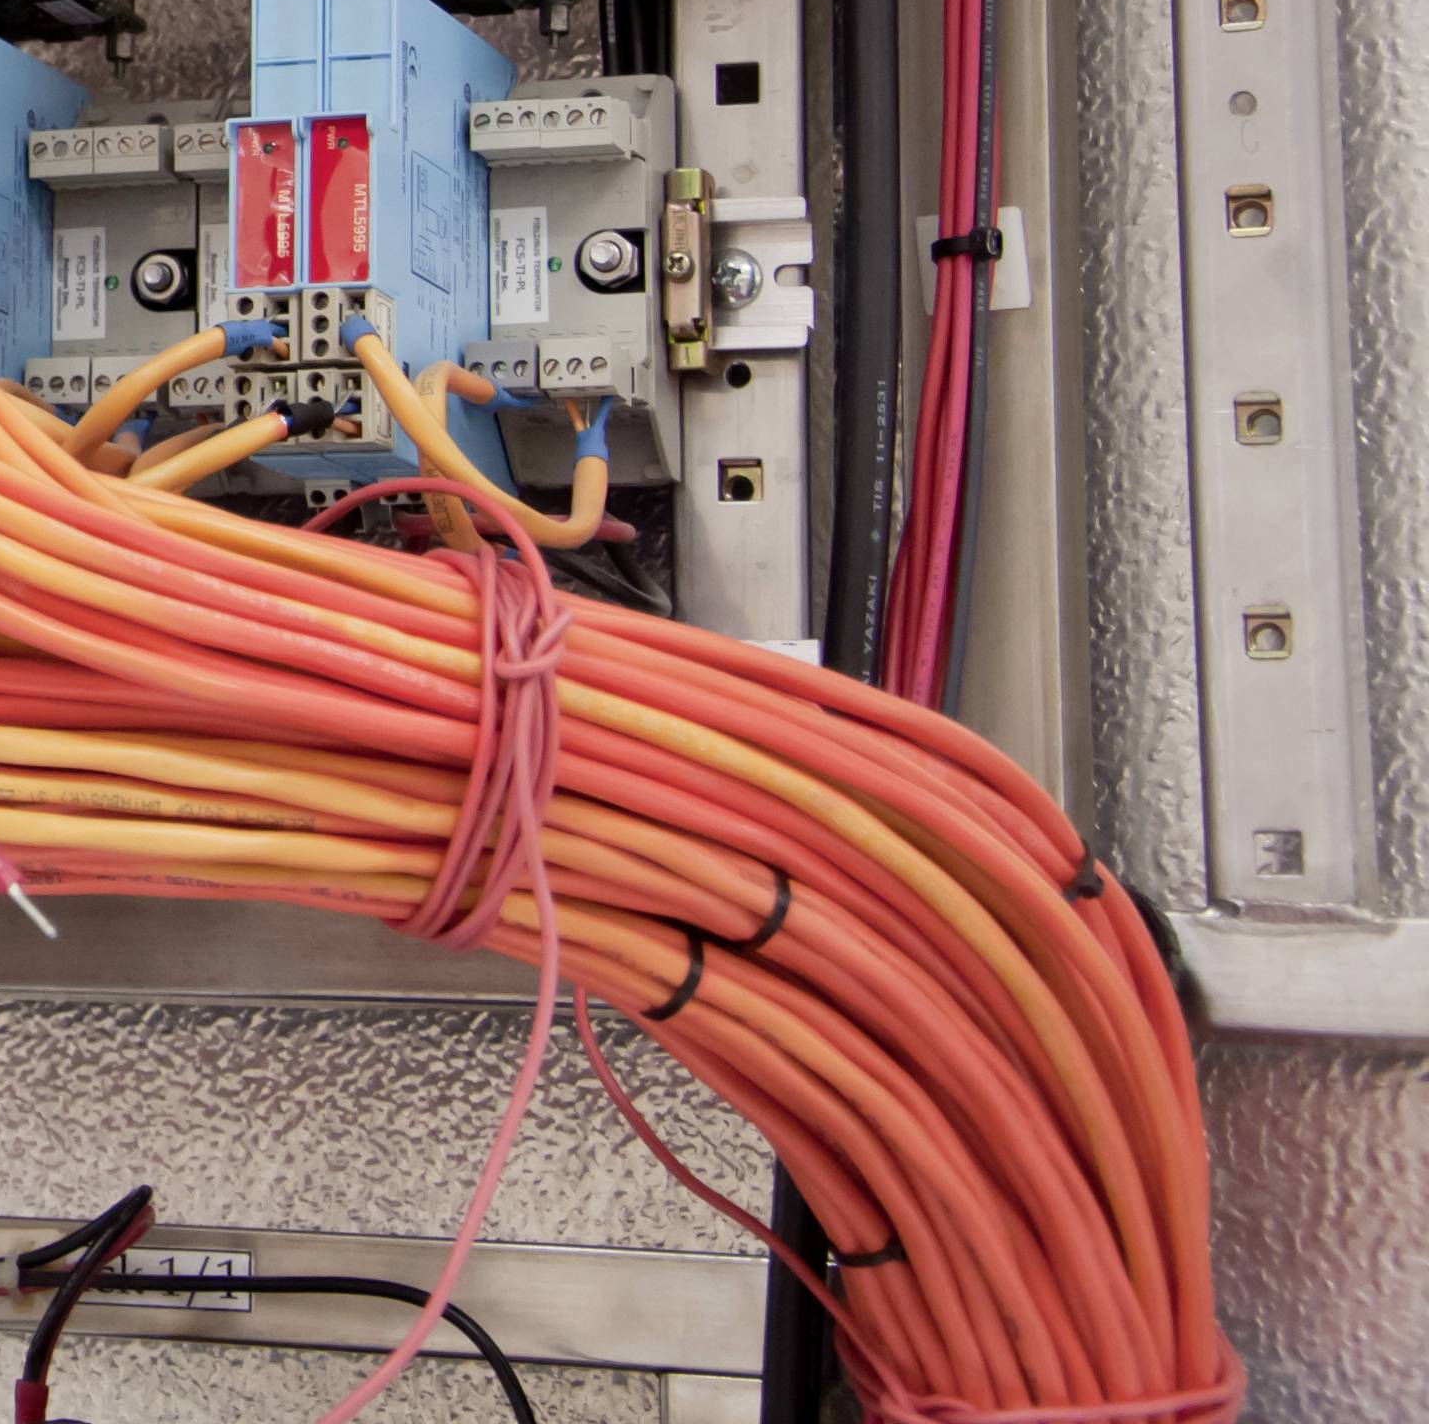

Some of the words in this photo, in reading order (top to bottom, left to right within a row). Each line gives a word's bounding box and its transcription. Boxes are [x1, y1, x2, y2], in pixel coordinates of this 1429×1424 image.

[325, 124, 336, 151] PWR
[352, 182, 367, 254] MTL5995
[75, 254, 86, 310] FCS-TI-PL
[515, 237, 526, 294] FCS-TI-PL
[874, 378, 887, 465] 11-2531
[872, 479, 886, 513] TIS
[862, 573, 879, 655] YAZAKI
